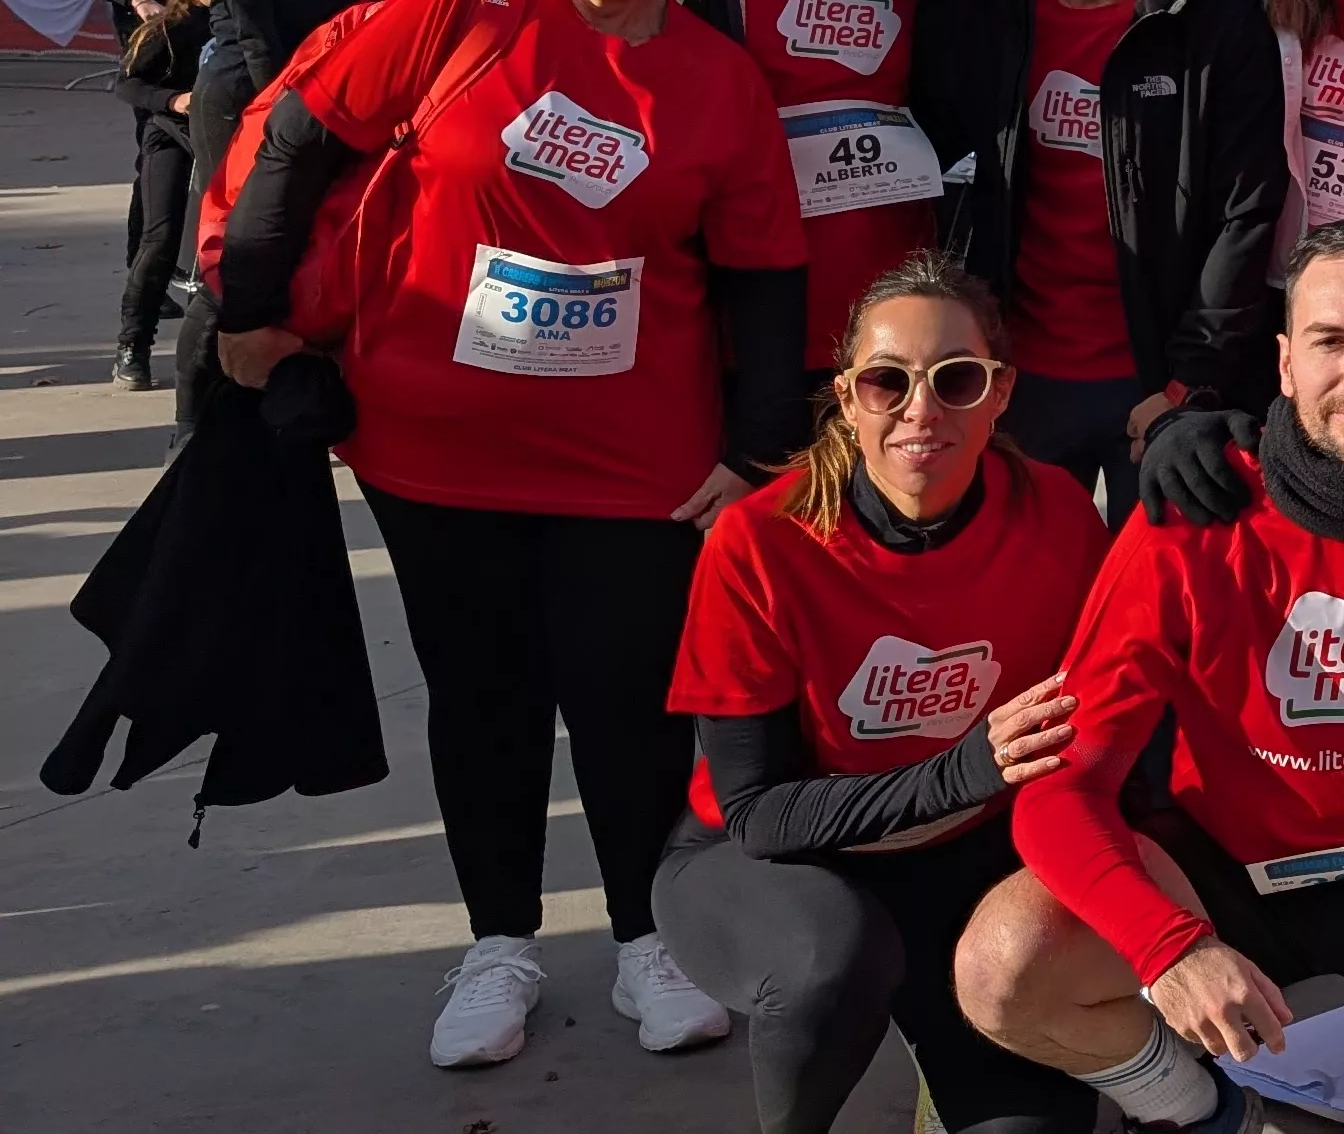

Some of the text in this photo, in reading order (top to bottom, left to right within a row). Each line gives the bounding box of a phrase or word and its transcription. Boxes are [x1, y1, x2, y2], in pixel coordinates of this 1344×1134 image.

[809, 21, 885, 49] meat
[1043, 90, 1100, 123] liter
[1058, 118, 1100, 141] me
[533, 140, 625, 184] meat
[829, 134, 881, 167] 49
[814, 161, 898, 185] ALBERTO
[501, 291, 618, 329] 3086
[535, 329, 572, 341] ANA
[882, 678, 980, 722] meat
